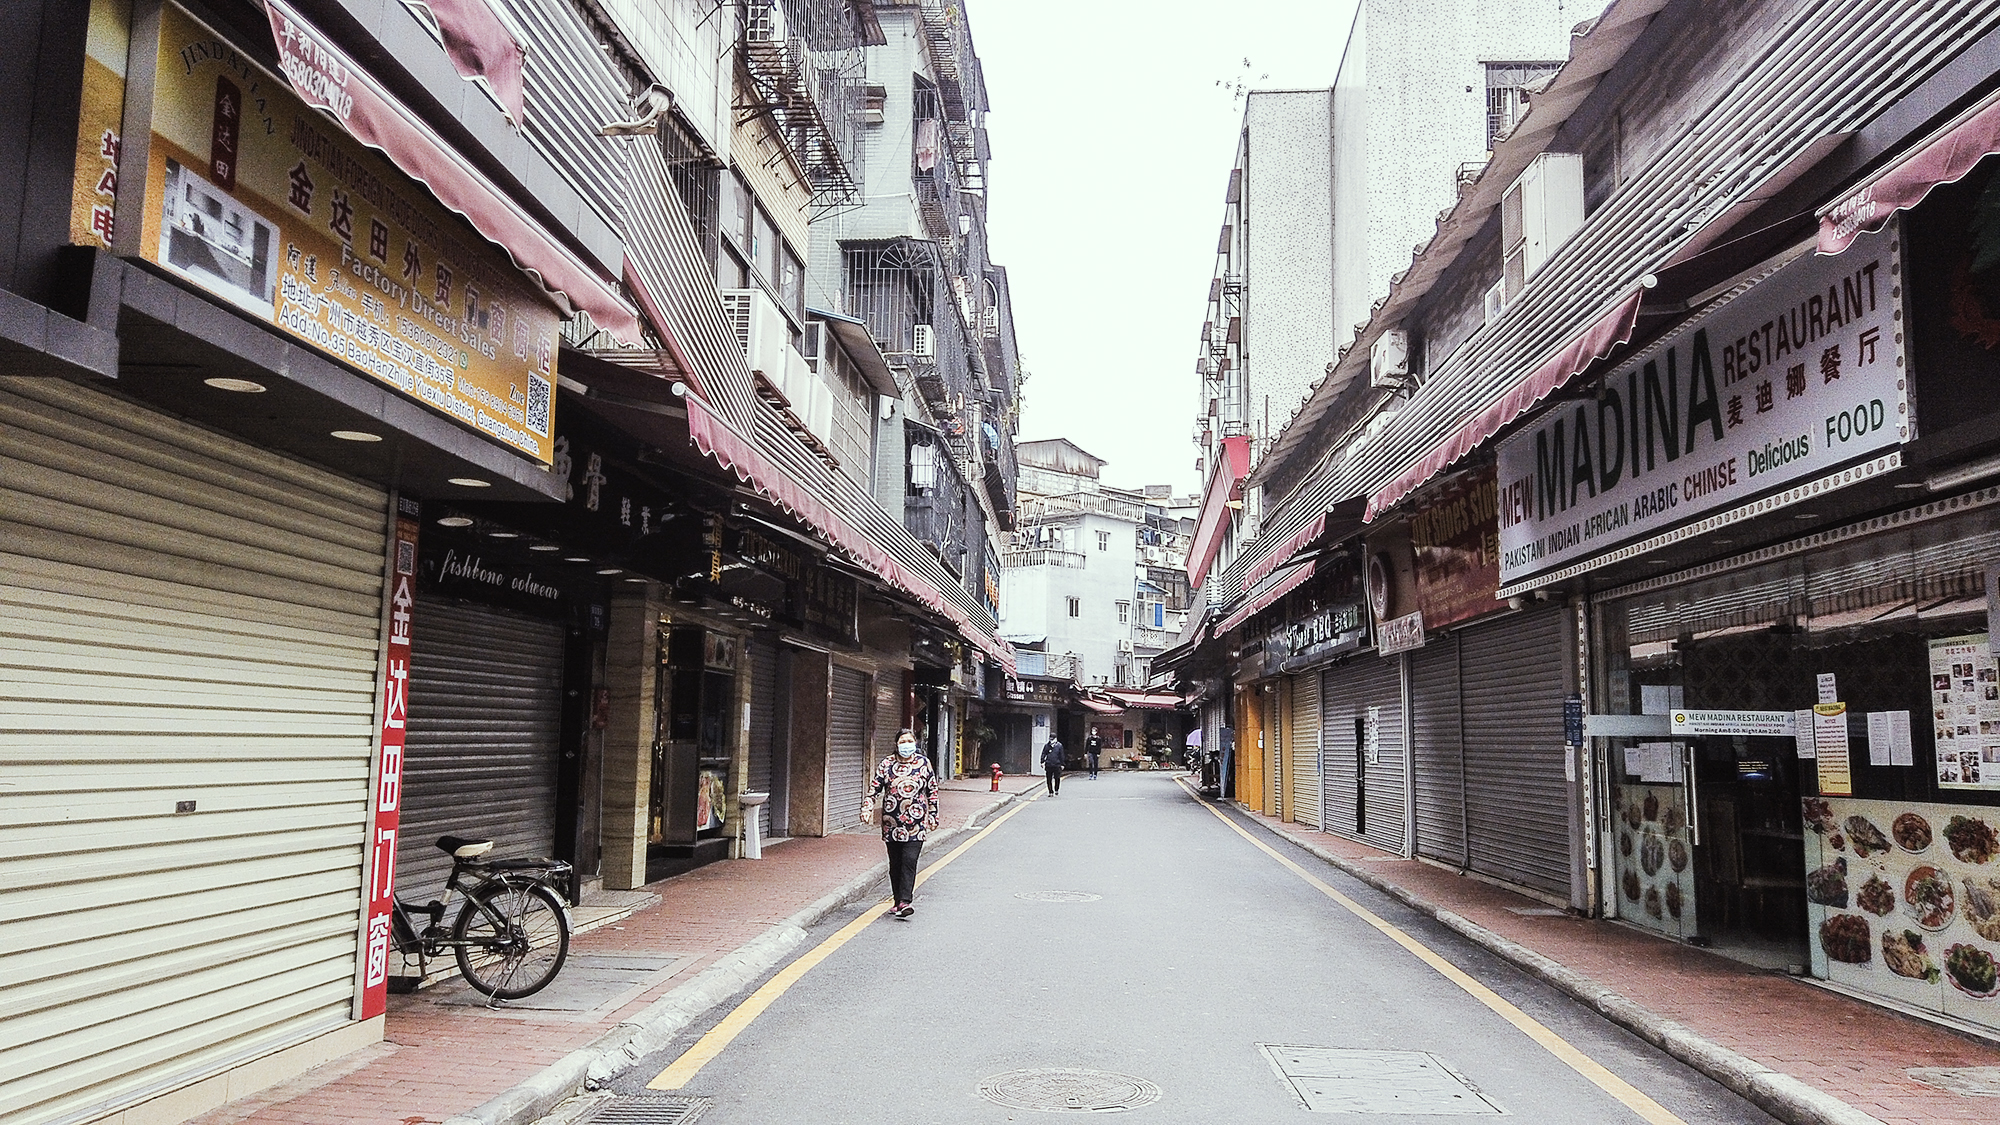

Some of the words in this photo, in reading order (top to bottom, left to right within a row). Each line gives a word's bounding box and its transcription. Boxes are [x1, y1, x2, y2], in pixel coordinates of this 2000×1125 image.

[341, 240, 408, 310] Factory
[411, 291, 457, 338] Direct
[459, 322, 496, 361] Sales
[1723, 260, 1880, 388] RESTAURANT
[1502, 473, 1535, 529] MEW
[1536, 327, 1724, 523] MADINA
[1727, 326, 1881, 430] 麦迪娜餐厅
[1504, 537, 1546, 571] PAKISTANI
[1547, 526, 1580, 556] INDIAN
[1583, 506, 1629, 547] AFRICAN
[1633, 485, 1679, 522] ARABIC
[1683, 458, 1738, 503] CHINSE
[1747, 433, 1810, 478] Delicious
[1825, 397, 1884, 449] FOOD
[439, 548, 505, 587] fishbone
[1689, 713, 1706, 721] MEW
[1707, 713, 1736, 721] MADINA
[1737, 714, 1785, 722] RESTAURANT
[367, 577, 413, 989] 金达田门窗
